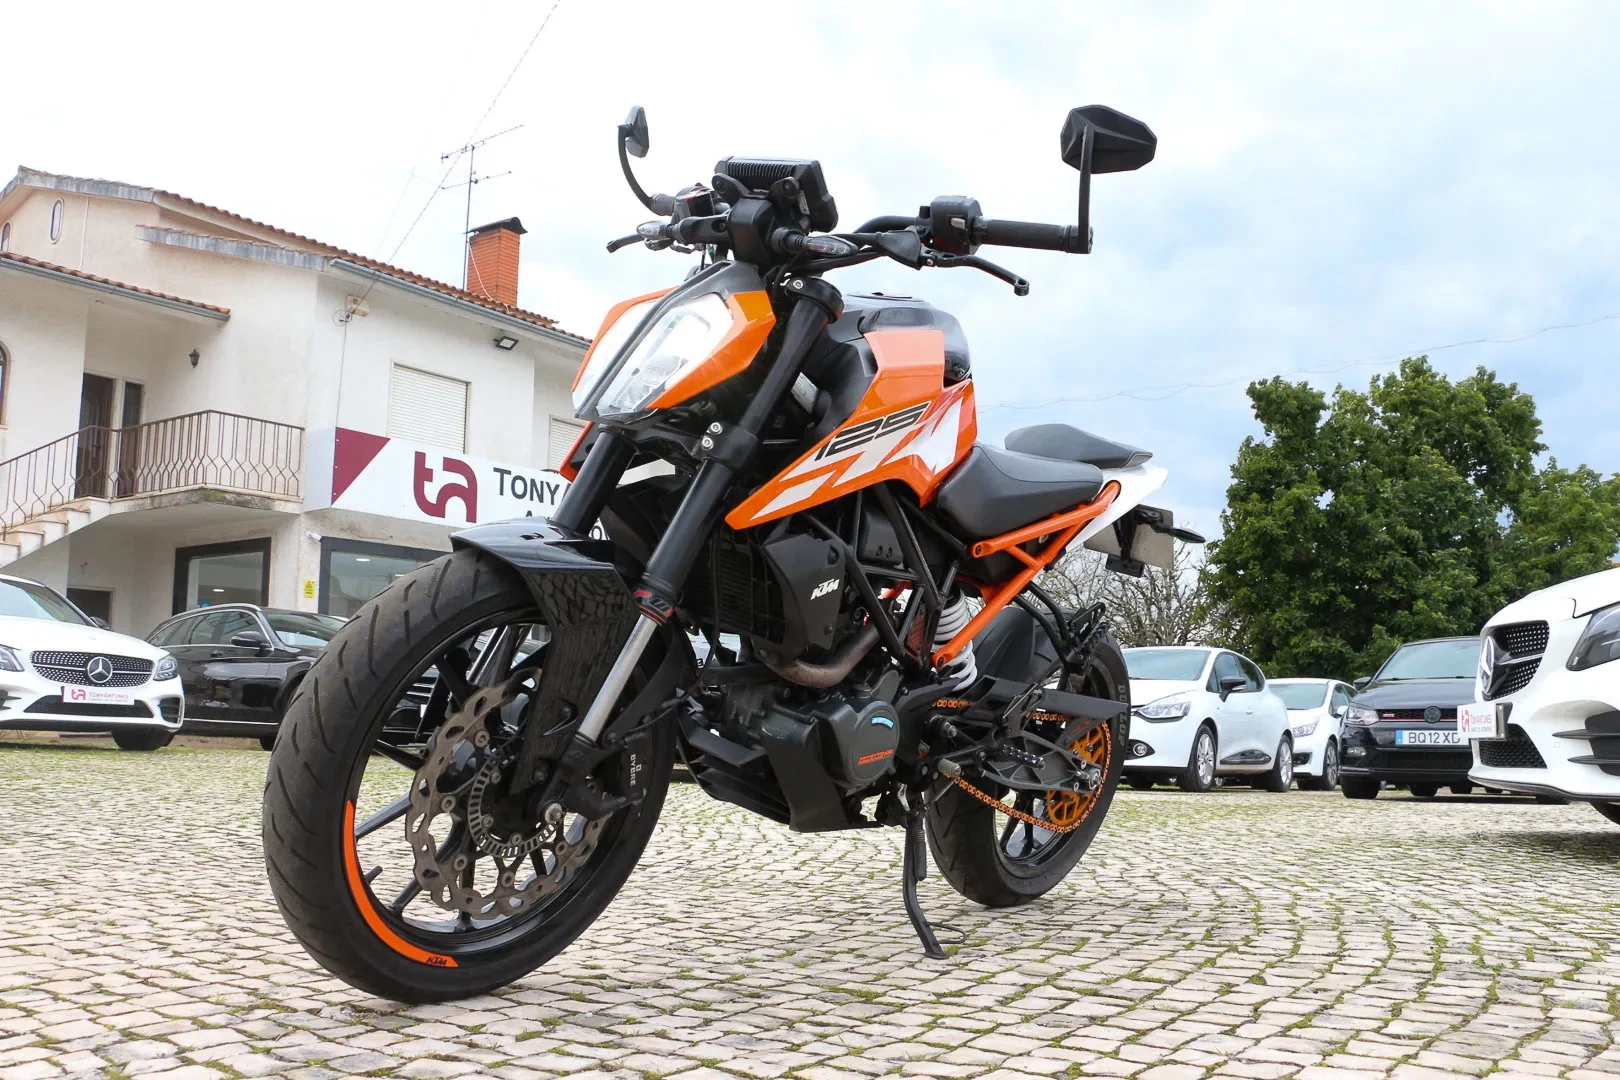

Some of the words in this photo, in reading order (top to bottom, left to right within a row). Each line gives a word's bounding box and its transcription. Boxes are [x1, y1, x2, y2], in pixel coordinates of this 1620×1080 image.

[814, 400, 932, 461] 125
[810, 578, 840, 601] KTM
[1118, 684, 1128, 746] DULOP
[426, 956, 447, 966] KTM
